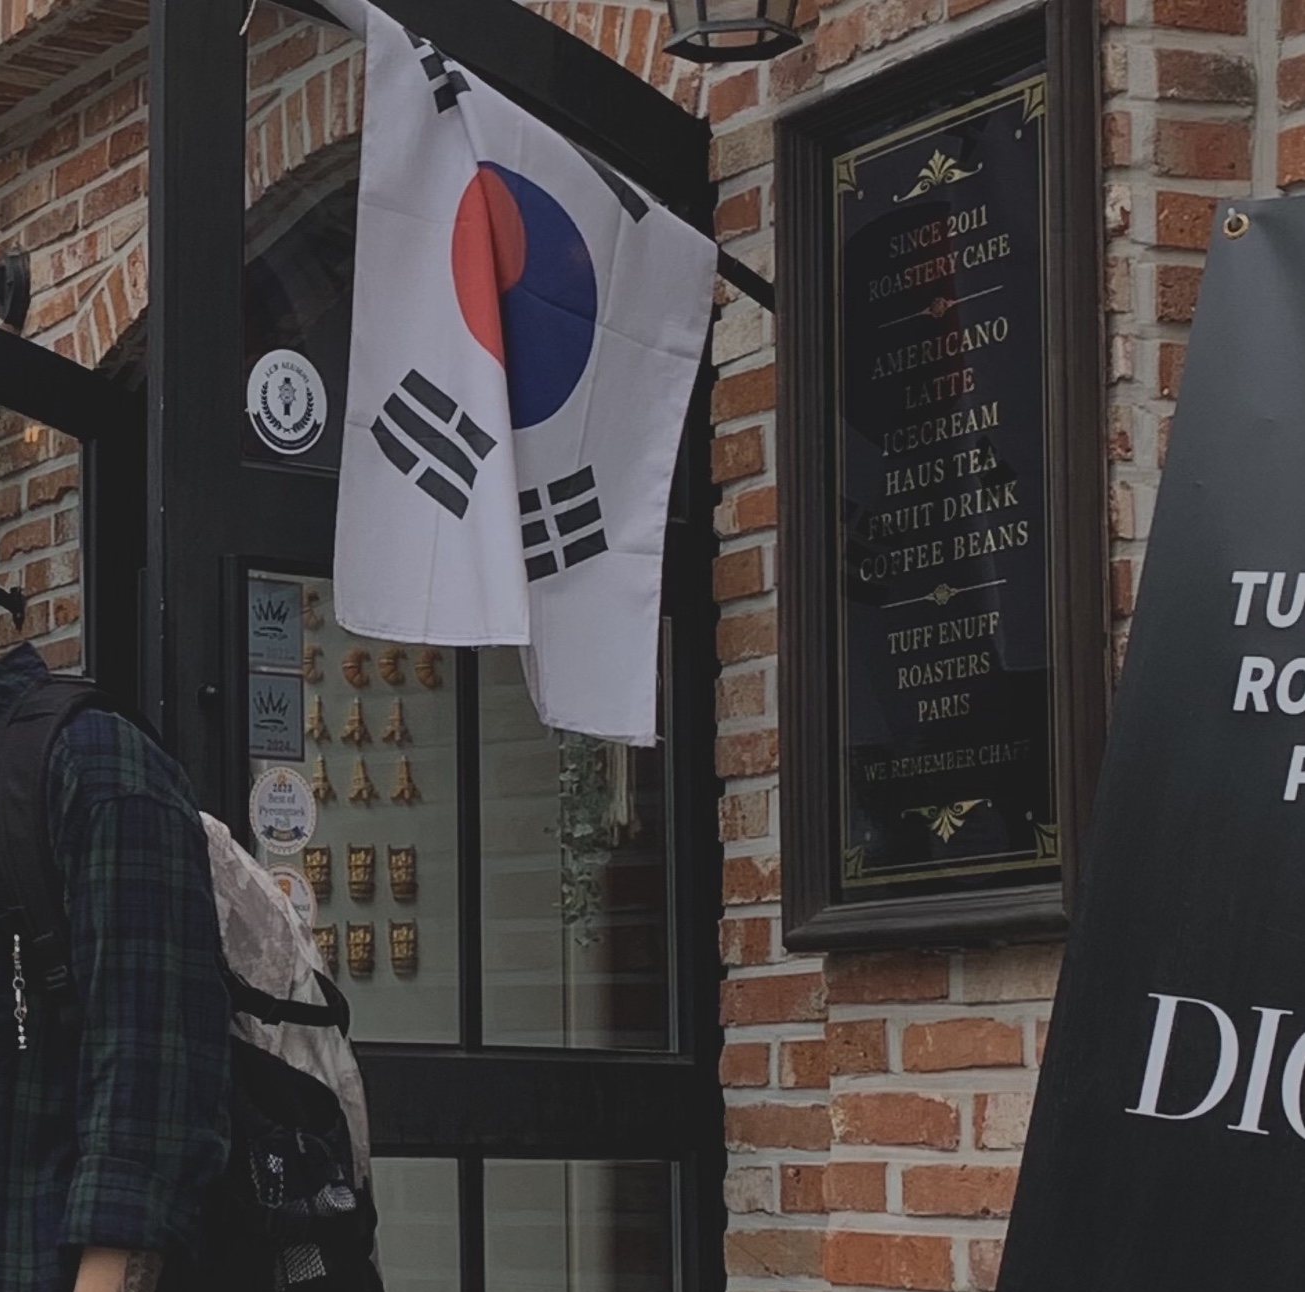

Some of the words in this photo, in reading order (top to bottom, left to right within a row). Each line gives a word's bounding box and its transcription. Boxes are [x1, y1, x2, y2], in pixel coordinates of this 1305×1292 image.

[889, 220, 942, 259] SINCE
[946, 204, 989, 239] 2011
[868, 252, 960, 303] ROASTERY
[963, 233, 1011, 269] CAFE
[871, 316, 1009, 380] AMERICANO
[904, 367, 976, 410] LATTE
[881, 401, 999, 457] ICECREAM
[885, 457, 944, 496] HAUS
[953, 446, 998, 477] TEA
[867, 502, 934, 541] FRUIT
[943, 480, 1019, 523] DRINK
[859, 540, 944, 583] COFFEE
[953, 520, 1029, 561] BEANS
[888, 626, 933, 655] TUFF
[939, 611, 1000, 646] ENUFF
[897, 651, 990, 690] ROASTERS
[917, 693, 970, 722] PARIS
[863, 762, 888, 782] WE
[891, 748, 976, 780] REMEMBER
